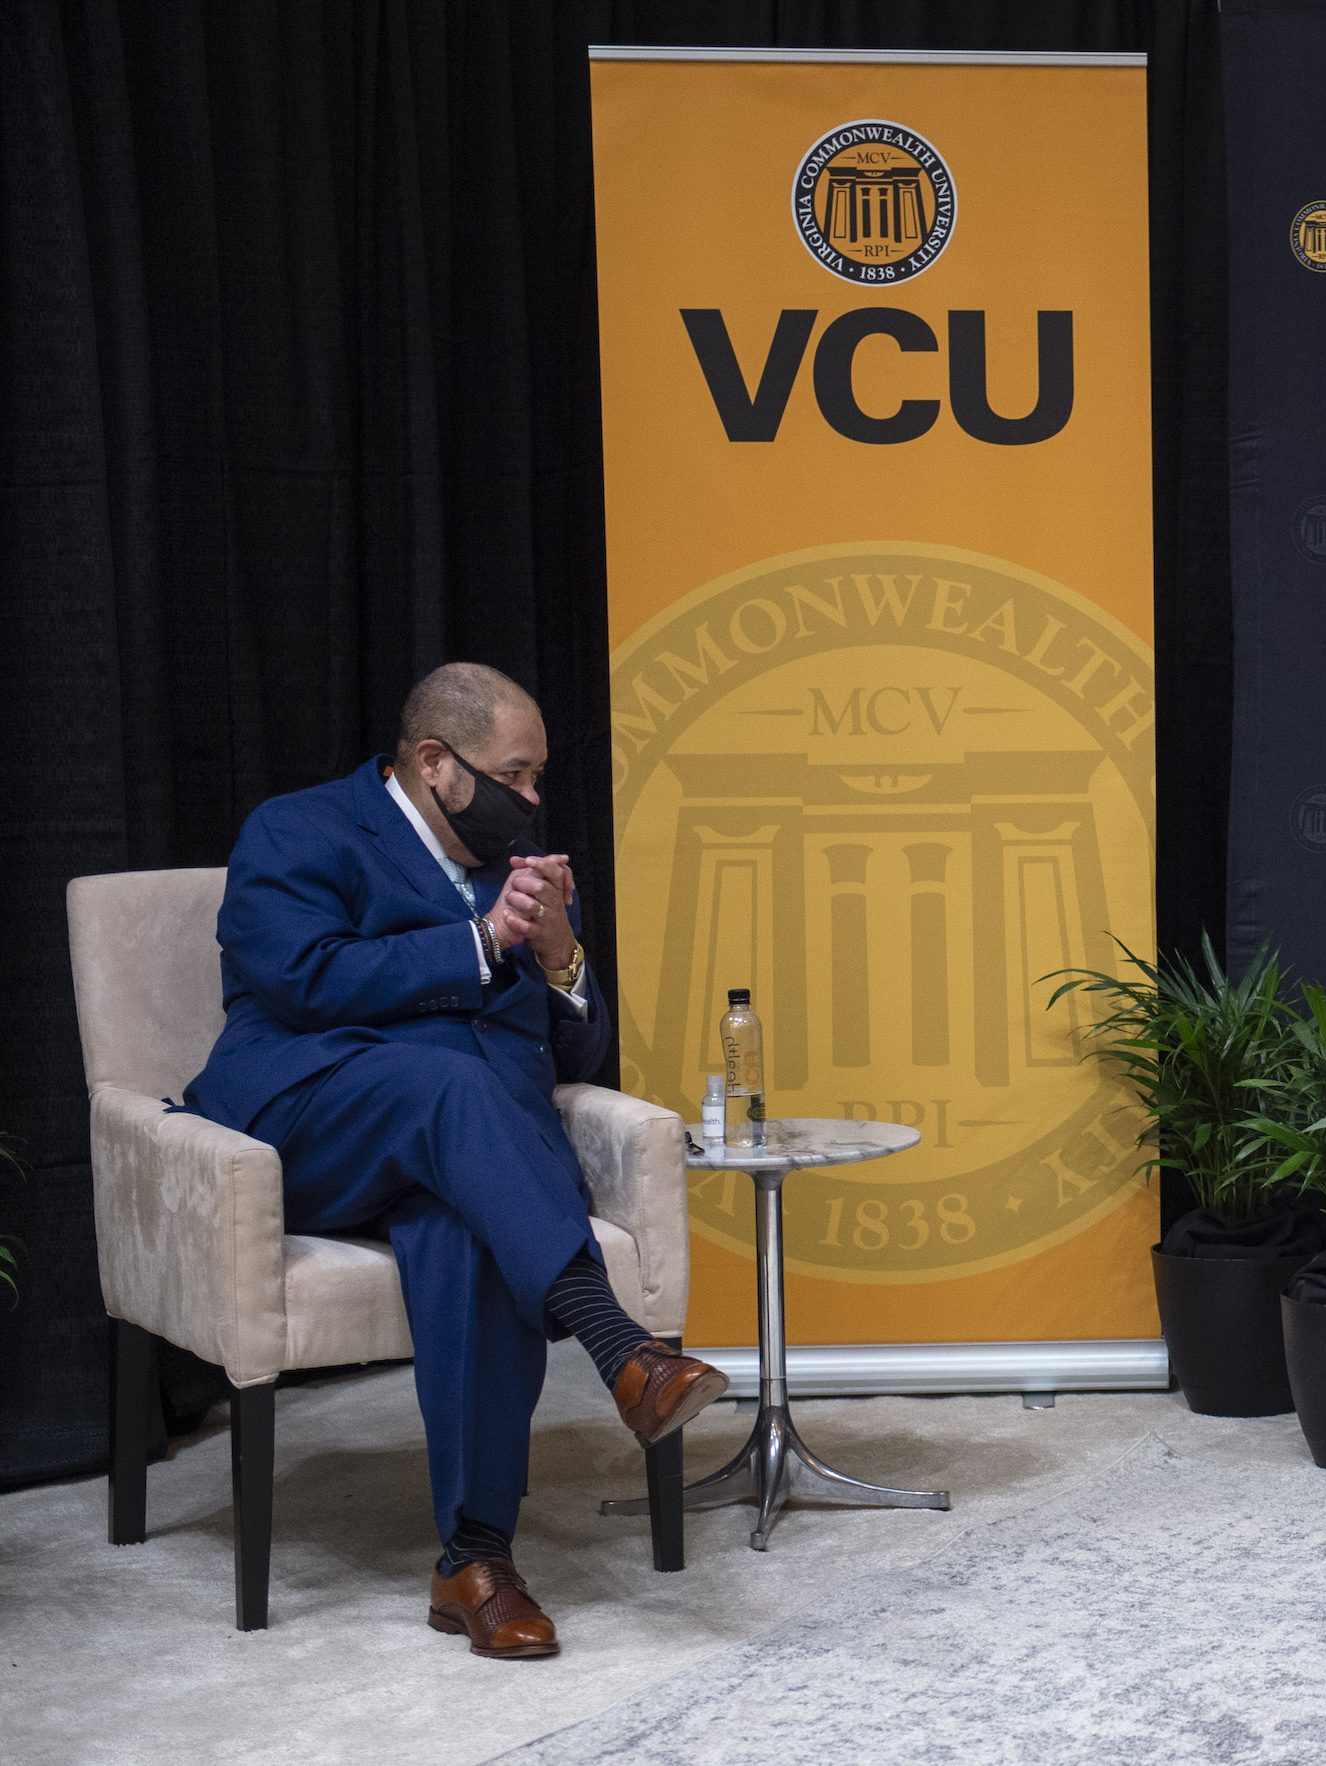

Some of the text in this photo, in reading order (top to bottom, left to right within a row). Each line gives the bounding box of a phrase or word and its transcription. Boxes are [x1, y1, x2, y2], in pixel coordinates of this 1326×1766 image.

[857, 152, 891, 164] MCV
[799, 127, 951, 271] VIRGINIA COMMONWEALTH UNIVERSITY
[859, 266, 895, 280] 1838
[864, 245, 890, 257] RPI
[678, 306, 1074, 445] VCU
[807, 686, 964, 738] MCV
[818, 1193, 976, 1250] 1838
